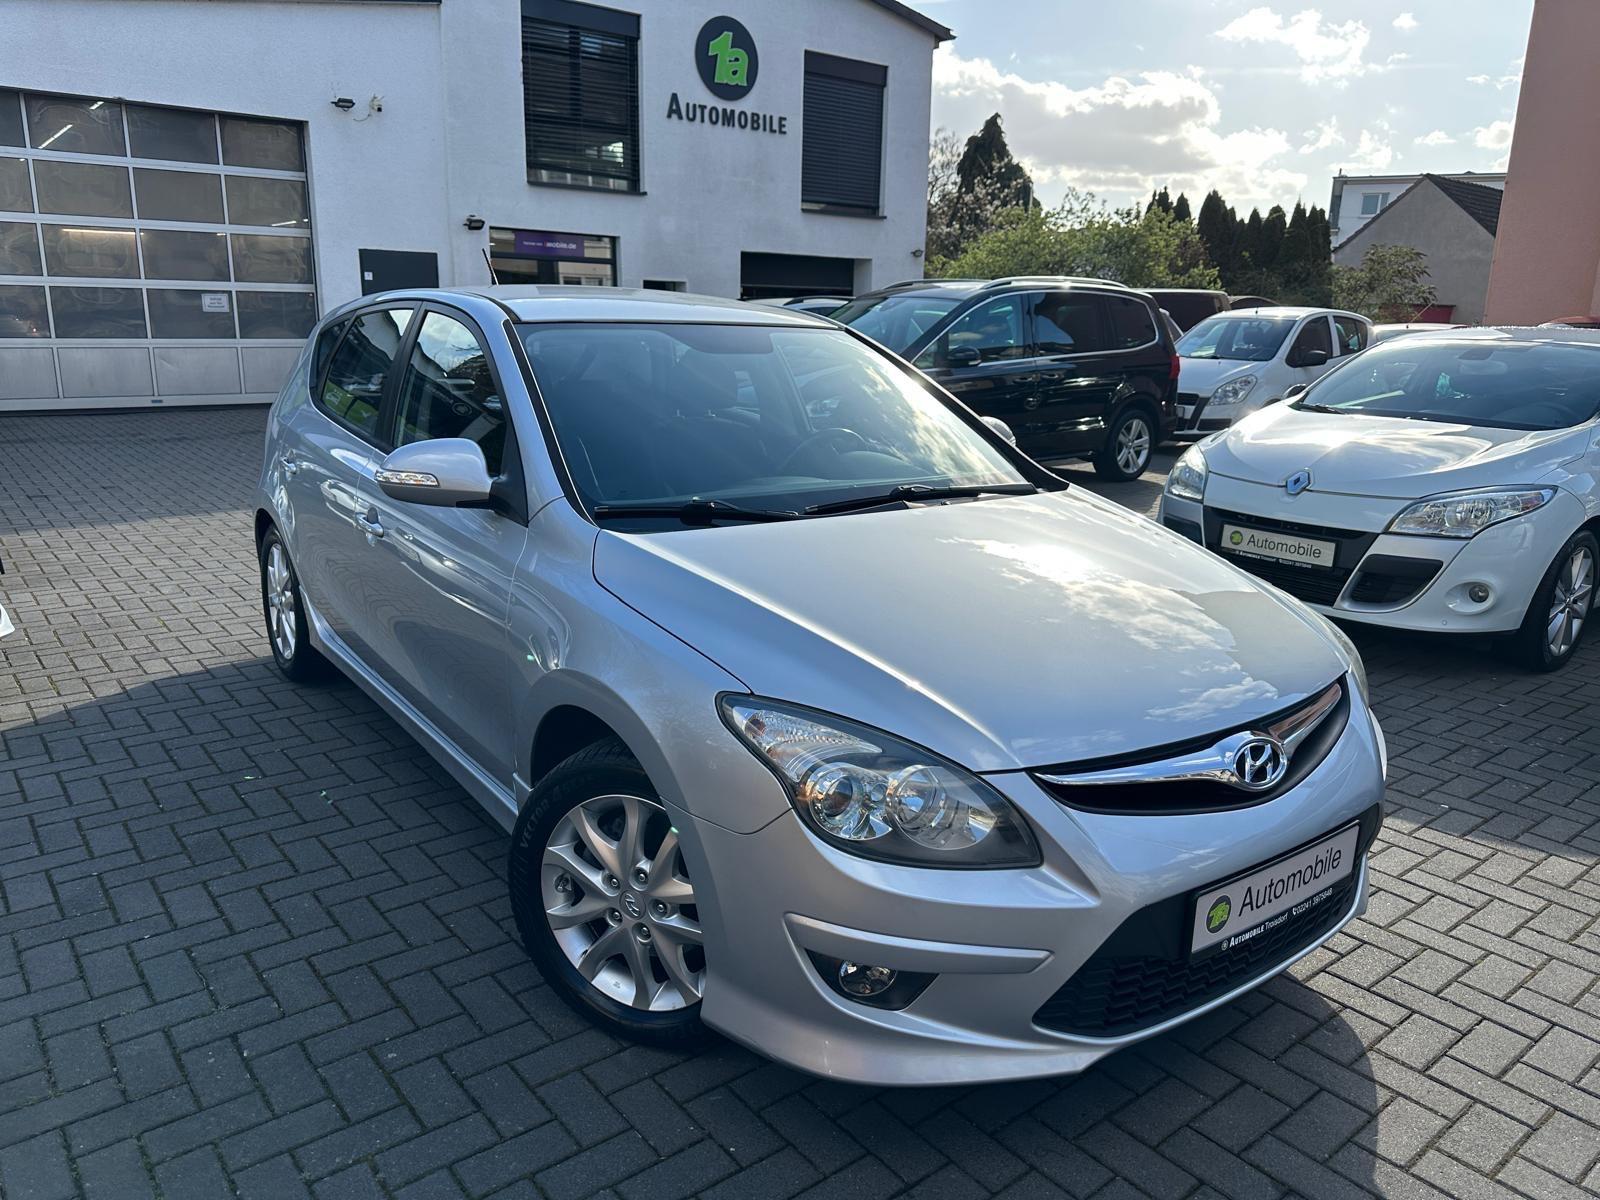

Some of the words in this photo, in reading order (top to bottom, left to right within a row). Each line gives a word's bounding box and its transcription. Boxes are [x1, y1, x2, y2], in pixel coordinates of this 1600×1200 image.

[708, 31, 748, 86] 1a
[667, 92, 787, 135] AUTOMOBILE
[1246, 534, 1321, 559] Automobile
[519, 798, 550, 849] VECTOR
[1238, 847, 1342, 917] Automobile
[1229, 924, 1264, 948] AUTOMOBILE
